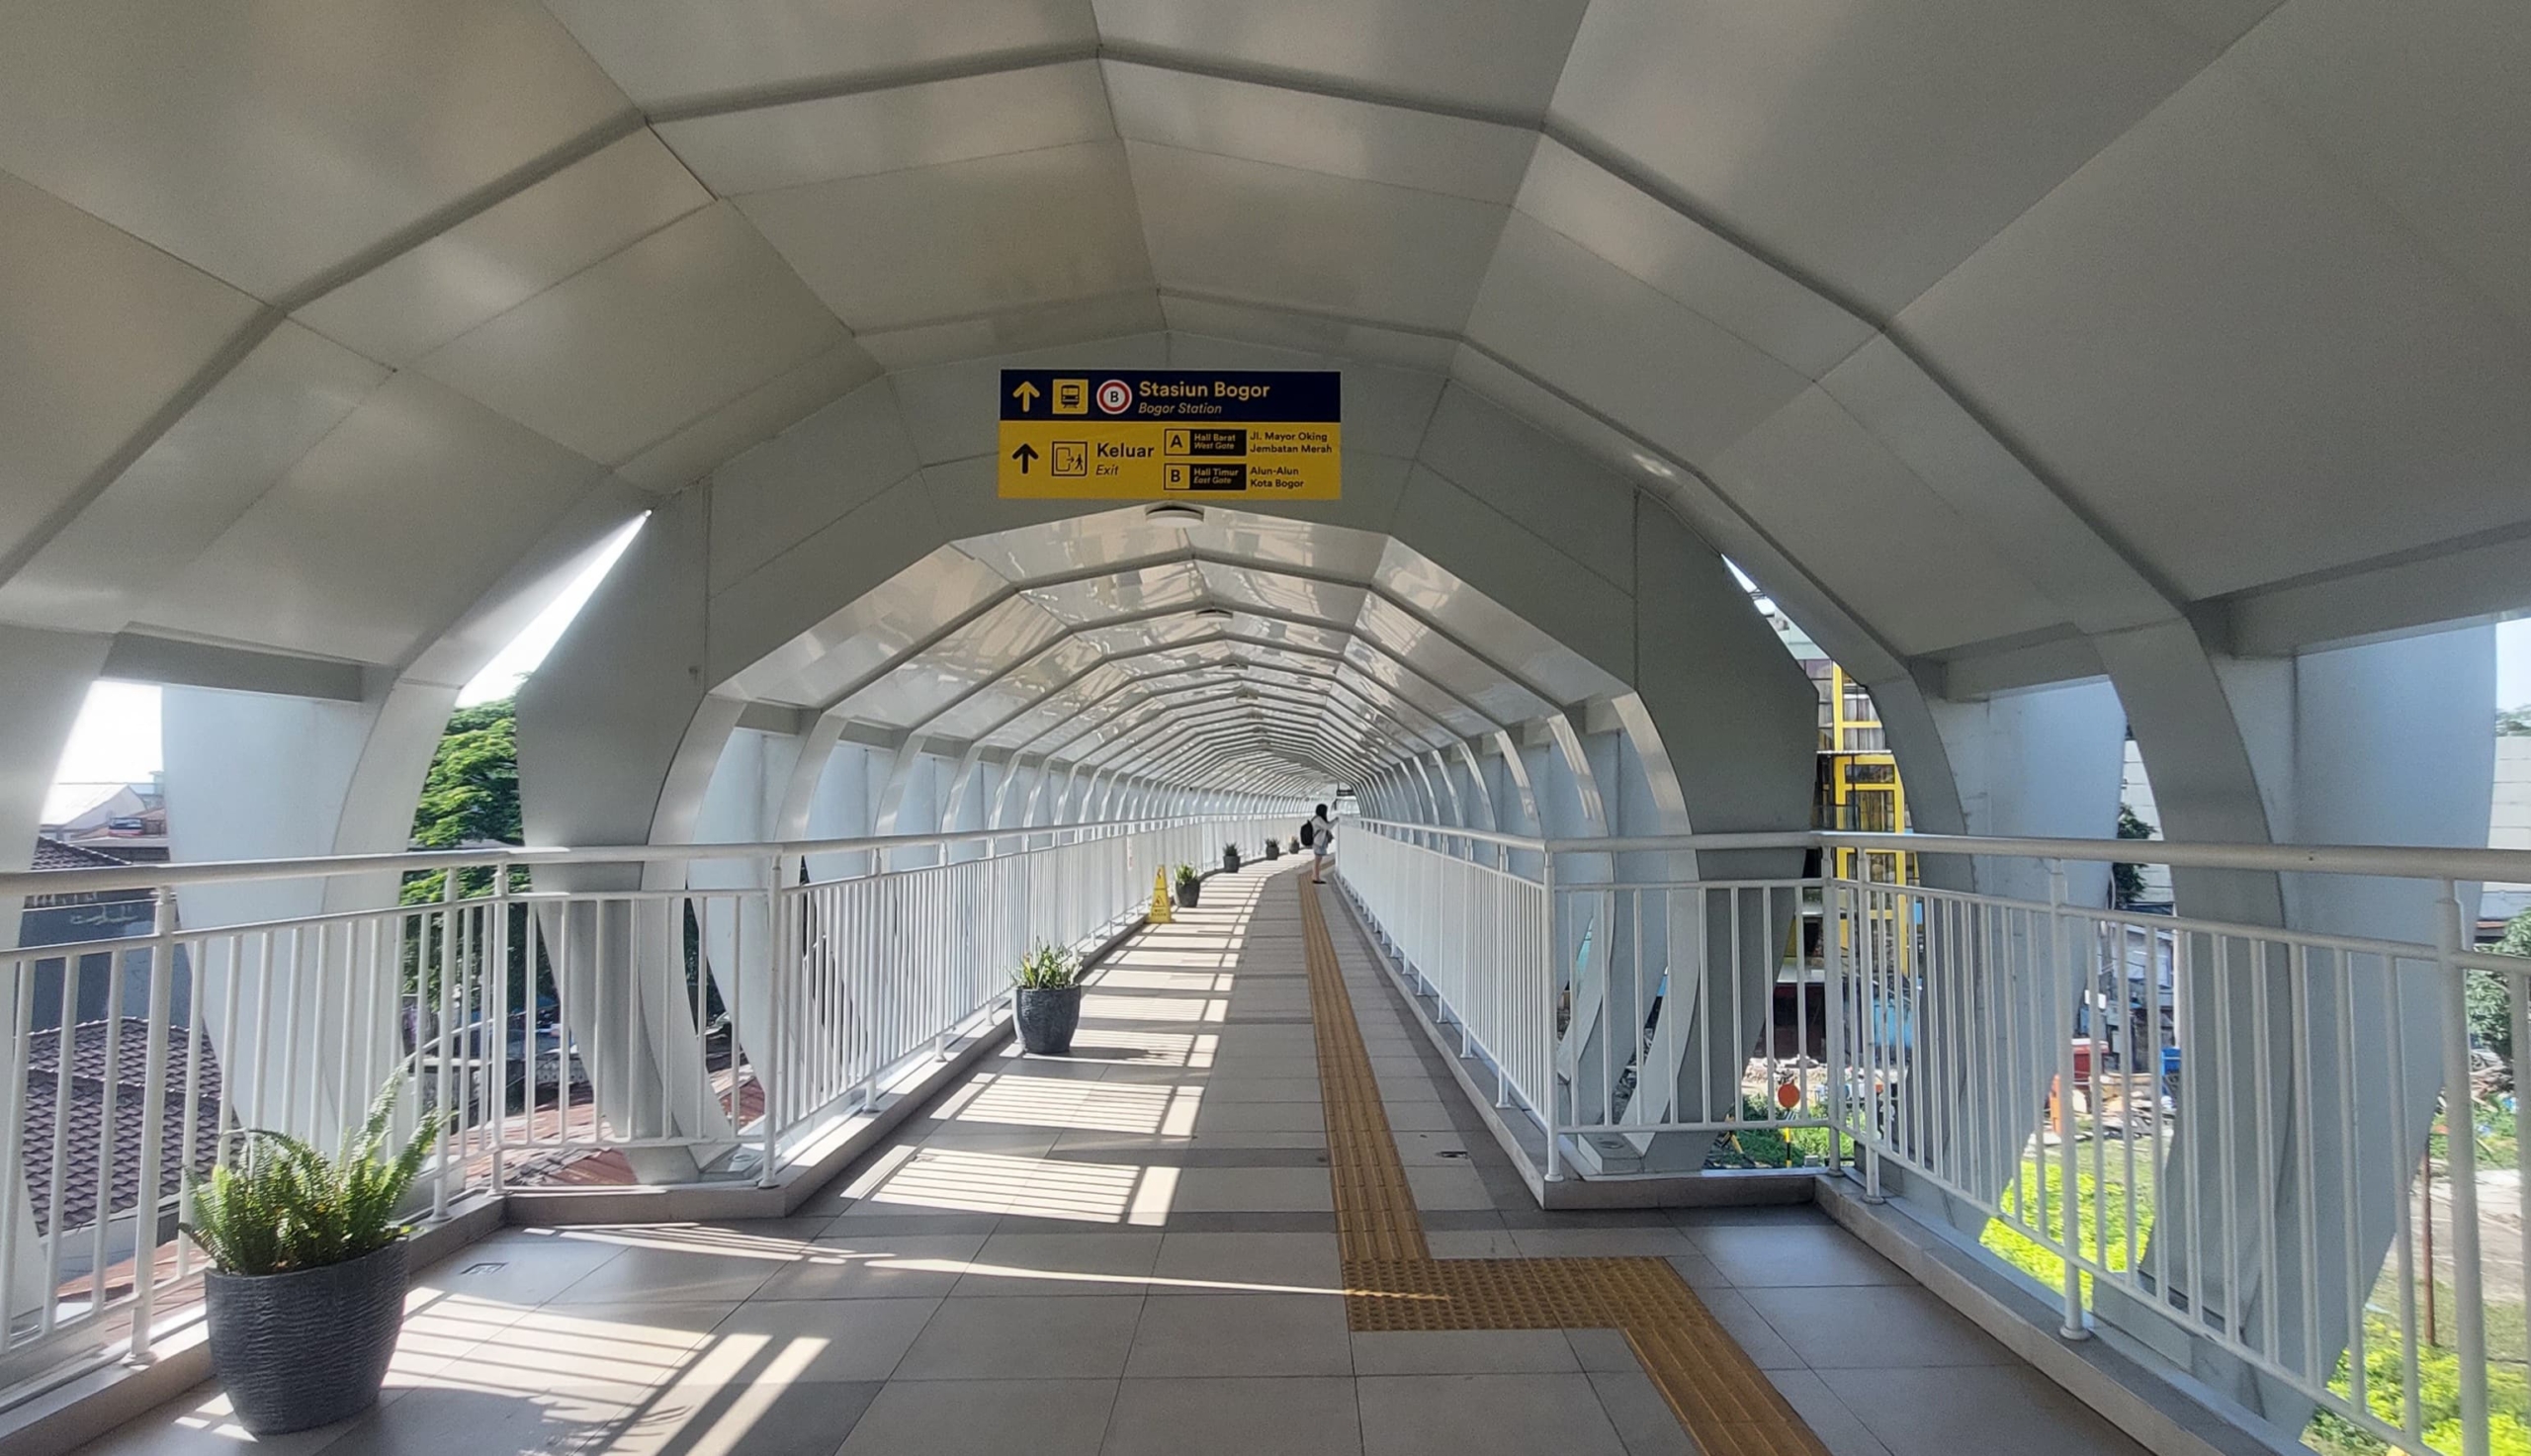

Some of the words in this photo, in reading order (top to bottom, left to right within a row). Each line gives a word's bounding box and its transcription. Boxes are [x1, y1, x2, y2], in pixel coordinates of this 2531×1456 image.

[1109, 390, 1119, 402] B
[1139, 381, 1208, 397] Stasiun
[1214, 381, 1270, 400] Bogor
[1138, 402, 1175, 416] Bogor
[1178, 402, 1222, 414] Station
[1170, 434, 1183, 448] A
[1193, 433, 1211, 442] Hall
[1213, 433, 1236, 442] Barat
[1250, 432, 1262, 441] Jl.
[1265, 432, 1296, 443] Mayor
[1298, 432, 1328, 443] Oking
[1096, 442, 1155, 458] Keluar
[1250, 445, 1299, 454] Jembatan
[1301, 445, 1333, 454] Merah
[1095, 464, 1119, 475] Exit
[1193, 468, 1211, 476] Hall
[1212, 468, 1239, 476] Timur
[1250, 467, 1299, 475] Alun-Alun
[1171, 470, 1181, 482] B
[1250, 479, 1272, 488] Kota
[1275, 479, 1304, 489] Bogor
